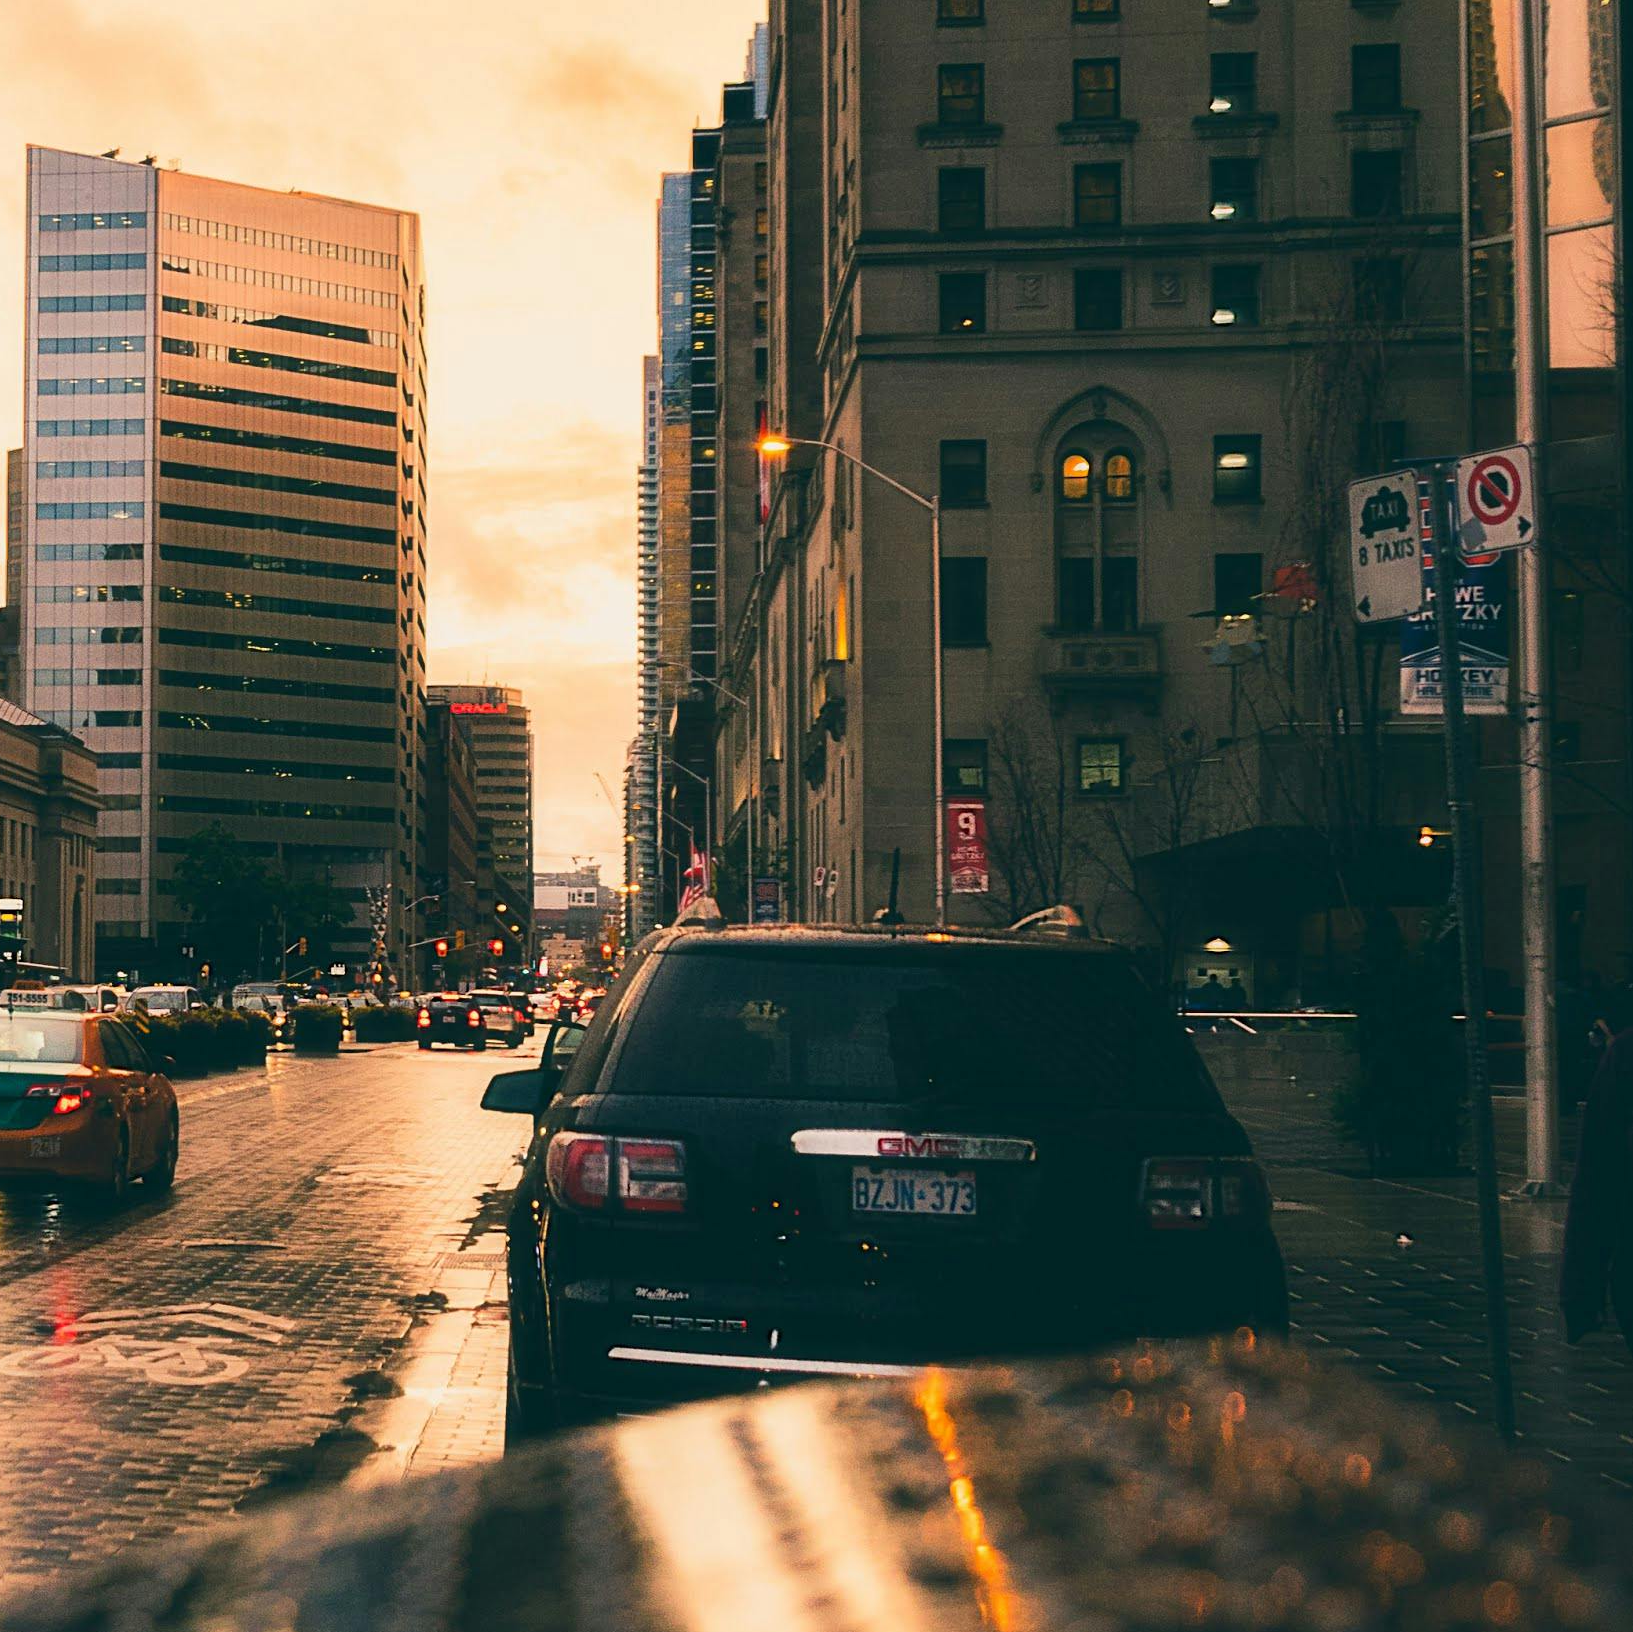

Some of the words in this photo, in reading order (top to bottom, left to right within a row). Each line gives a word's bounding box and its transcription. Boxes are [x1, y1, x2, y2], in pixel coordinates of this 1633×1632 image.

[1369, 499, 1399, 520] TAXI
[1358, 547, 1368, 566] 8
[1425, 586, 1485, 602] HWE
[1415, 669, 1494, 683] HOKEY
[450, 702, 508, 714] ORACLE
[958, 812, 976, 840] 9
[7, 993, 48, 1004] 751-5555
[878, 1137, 960, 1156] GMC
[631, 1314, 748, 1333] ACADIA
